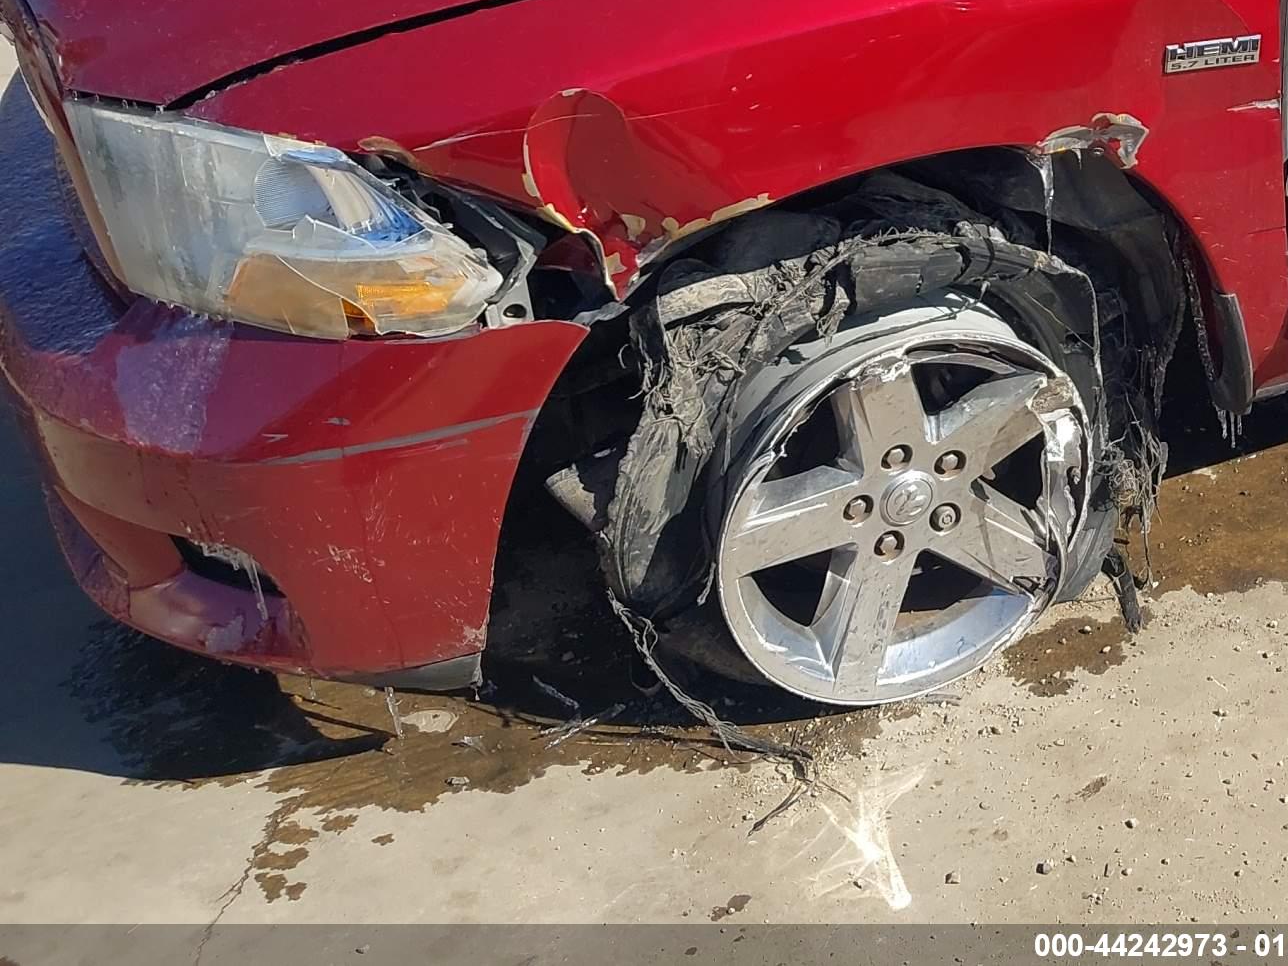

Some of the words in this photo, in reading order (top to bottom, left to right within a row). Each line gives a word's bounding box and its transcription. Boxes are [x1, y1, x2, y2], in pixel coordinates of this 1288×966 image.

[1166, 34, 1261, 62] HEMI
[1170, 60, 1199, 71] 5.7
[1204, 54, 1256, 67] LITER
